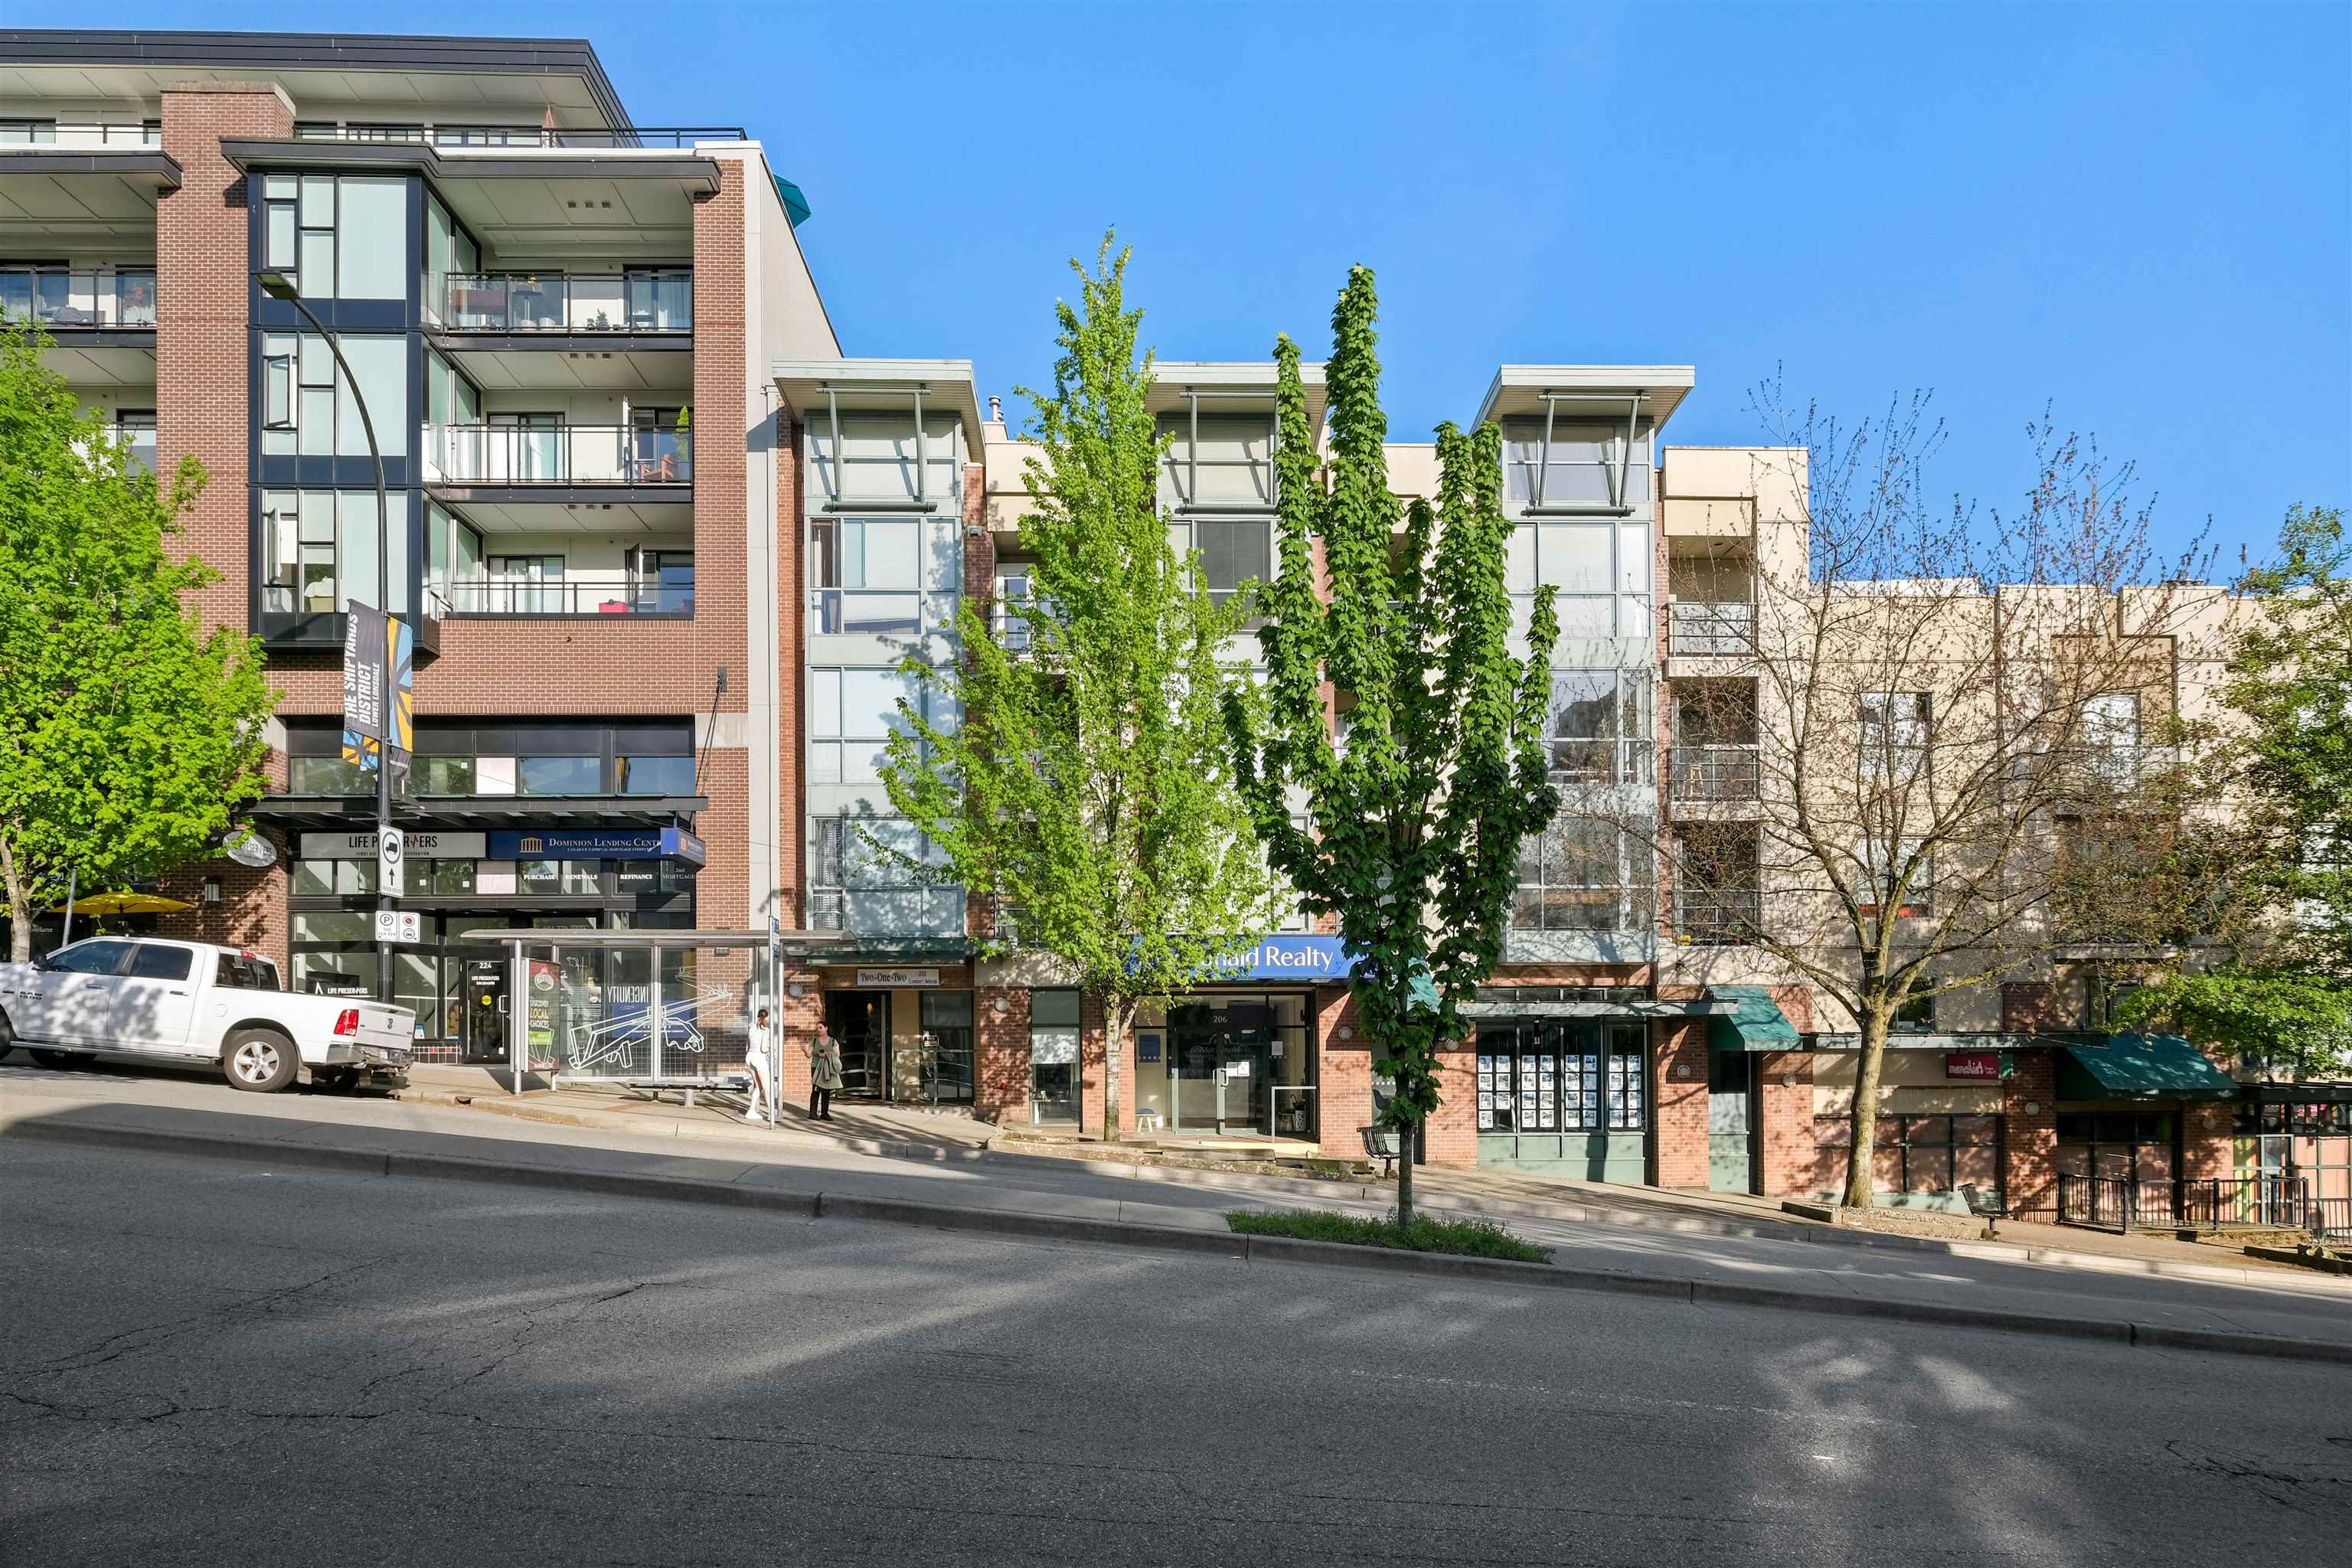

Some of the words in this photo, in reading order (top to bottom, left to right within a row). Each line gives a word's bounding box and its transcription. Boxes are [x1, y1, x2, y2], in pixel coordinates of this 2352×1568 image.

[344, 612, 359, 691] SHIPYARDS
[358, 661, 371, 724] DISTRICT
[371, 662, 381, 700] LONSDALE
[345, 694, 358, 720] THE
[371, 700, 380, 727] LOWER
[348, 835, 369, 848] LIFE
[549, 838, 593, 847] DOMINION
[594, 837, 632, 847] LENDING
[1266, 946, 1334, 972] Realty
[529, 1008, 549, 1019] LOCAL
[529, 1019, 550, 1028] CHOICES
[1213, 1015, 1228, 1024] 206
